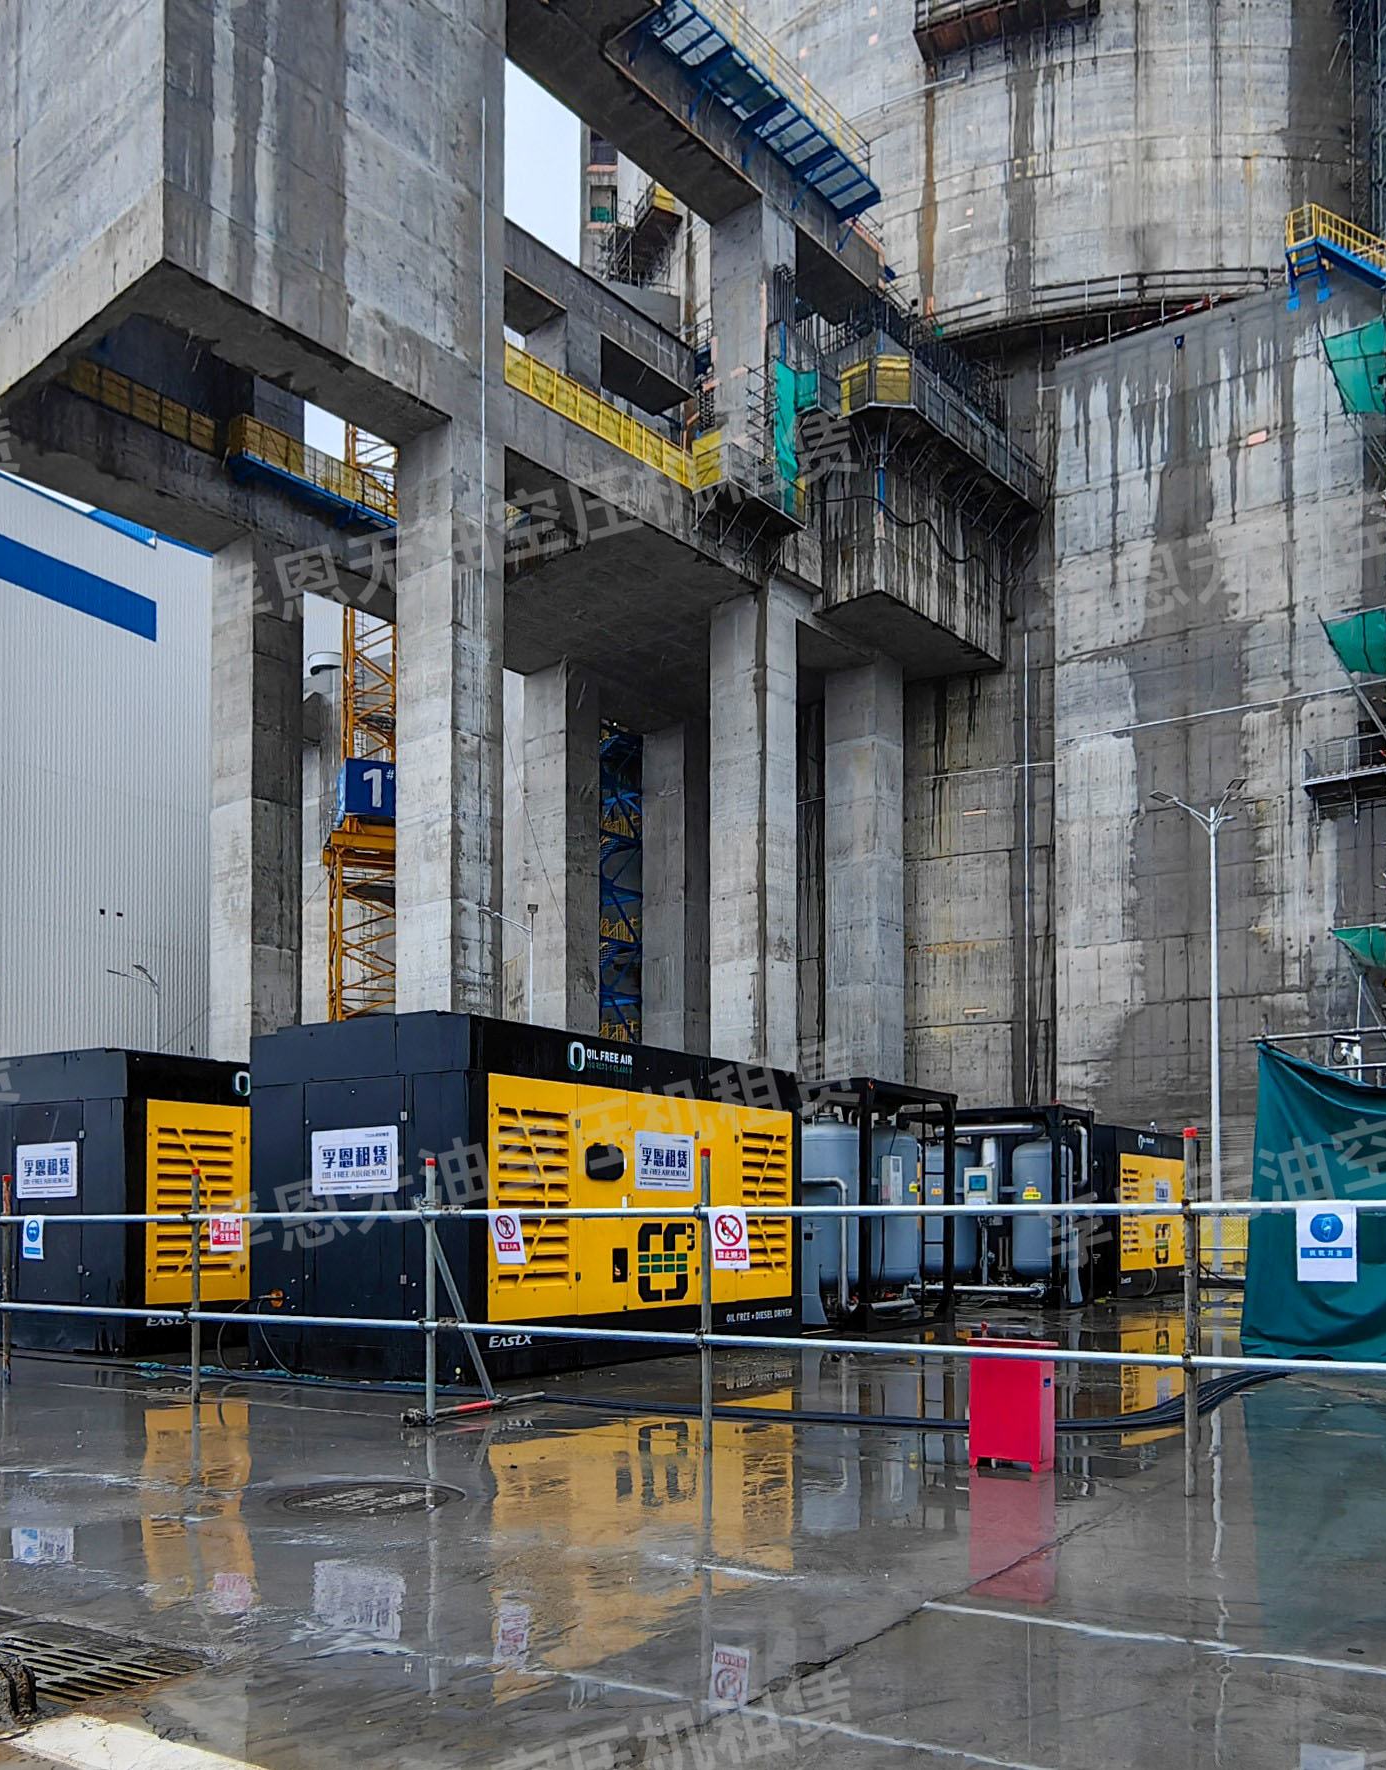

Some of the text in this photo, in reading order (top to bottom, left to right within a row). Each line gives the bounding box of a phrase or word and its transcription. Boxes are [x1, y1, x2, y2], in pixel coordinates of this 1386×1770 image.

[586, 1048, 633, 1066] OIL FREE AIR
[322, 1145, 388, 1169] 孚恩租赁
[641, 1147, 688, 1169] 孚恩租赁
